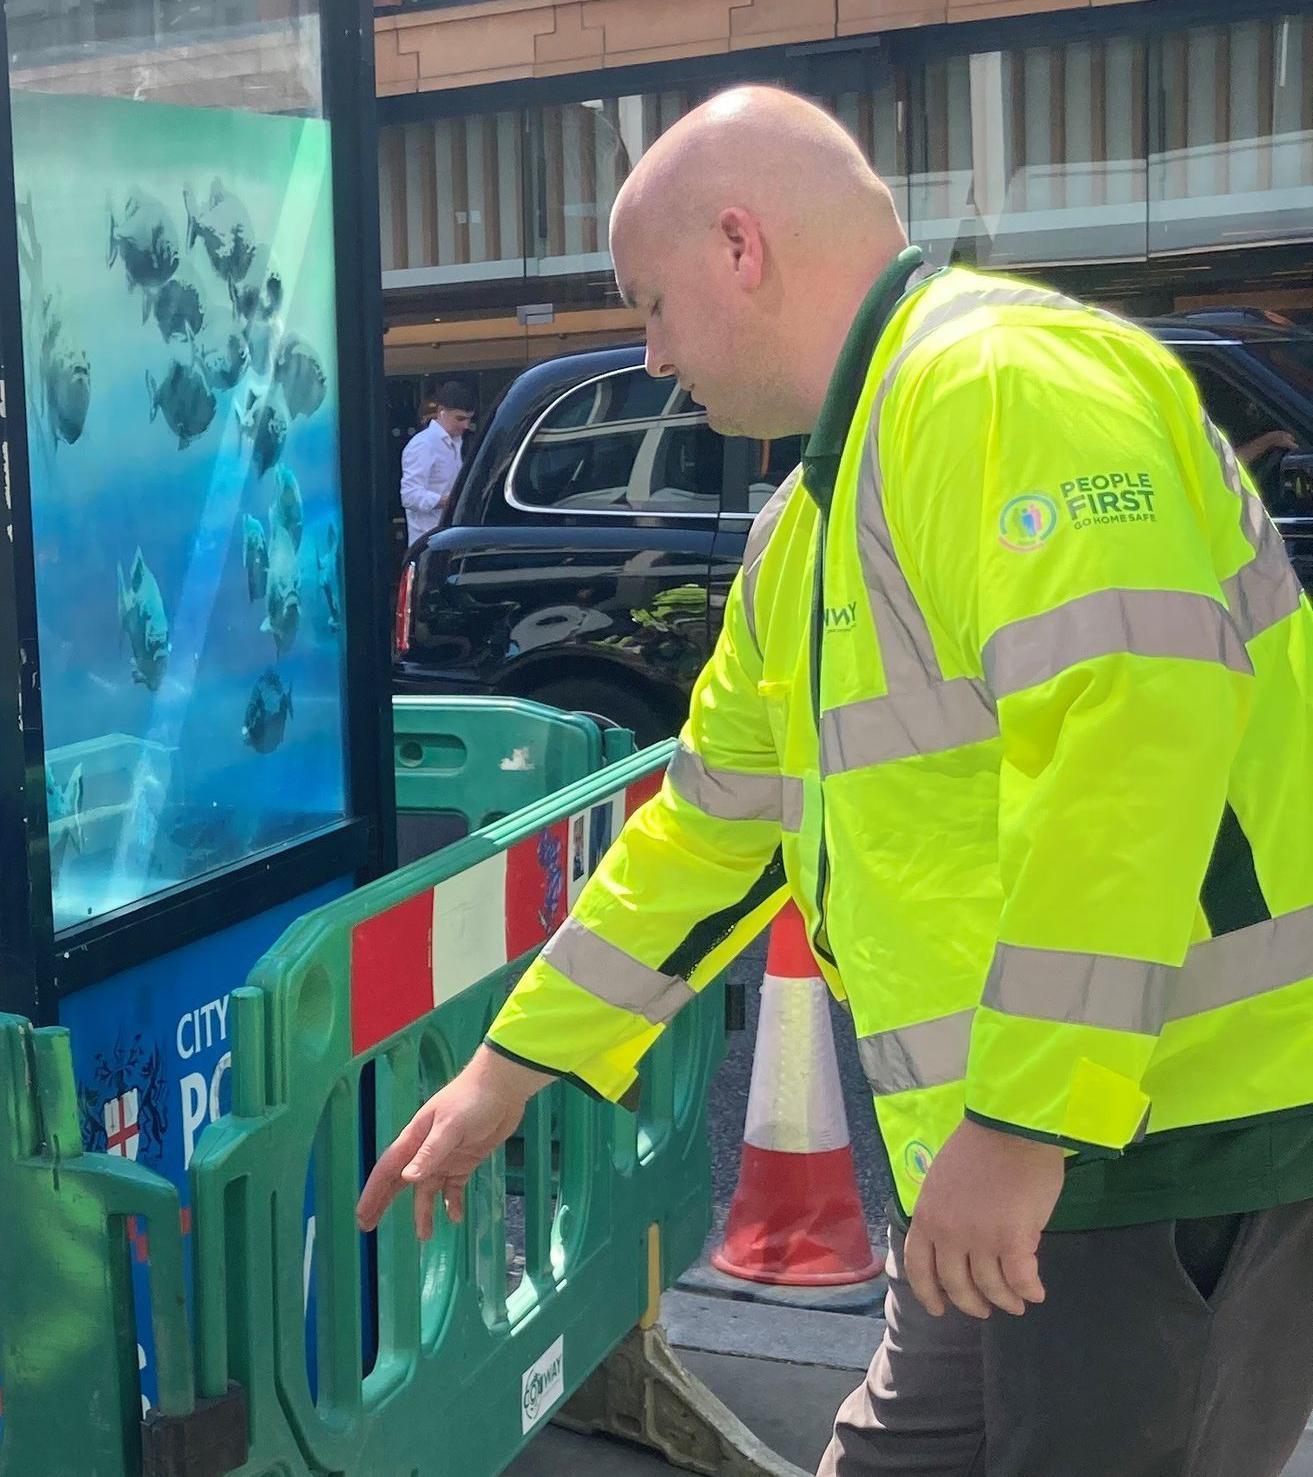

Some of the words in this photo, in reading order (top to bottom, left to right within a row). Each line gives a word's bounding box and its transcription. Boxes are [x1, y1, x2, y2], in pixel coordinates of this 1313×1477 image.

[1060, 472, 1153, 498] PEOPLE
[1066, 489, 1155, 521] FIRST
[1073, 518, 1092, 530] GO
[176, 994, 230, 1060] CITY
